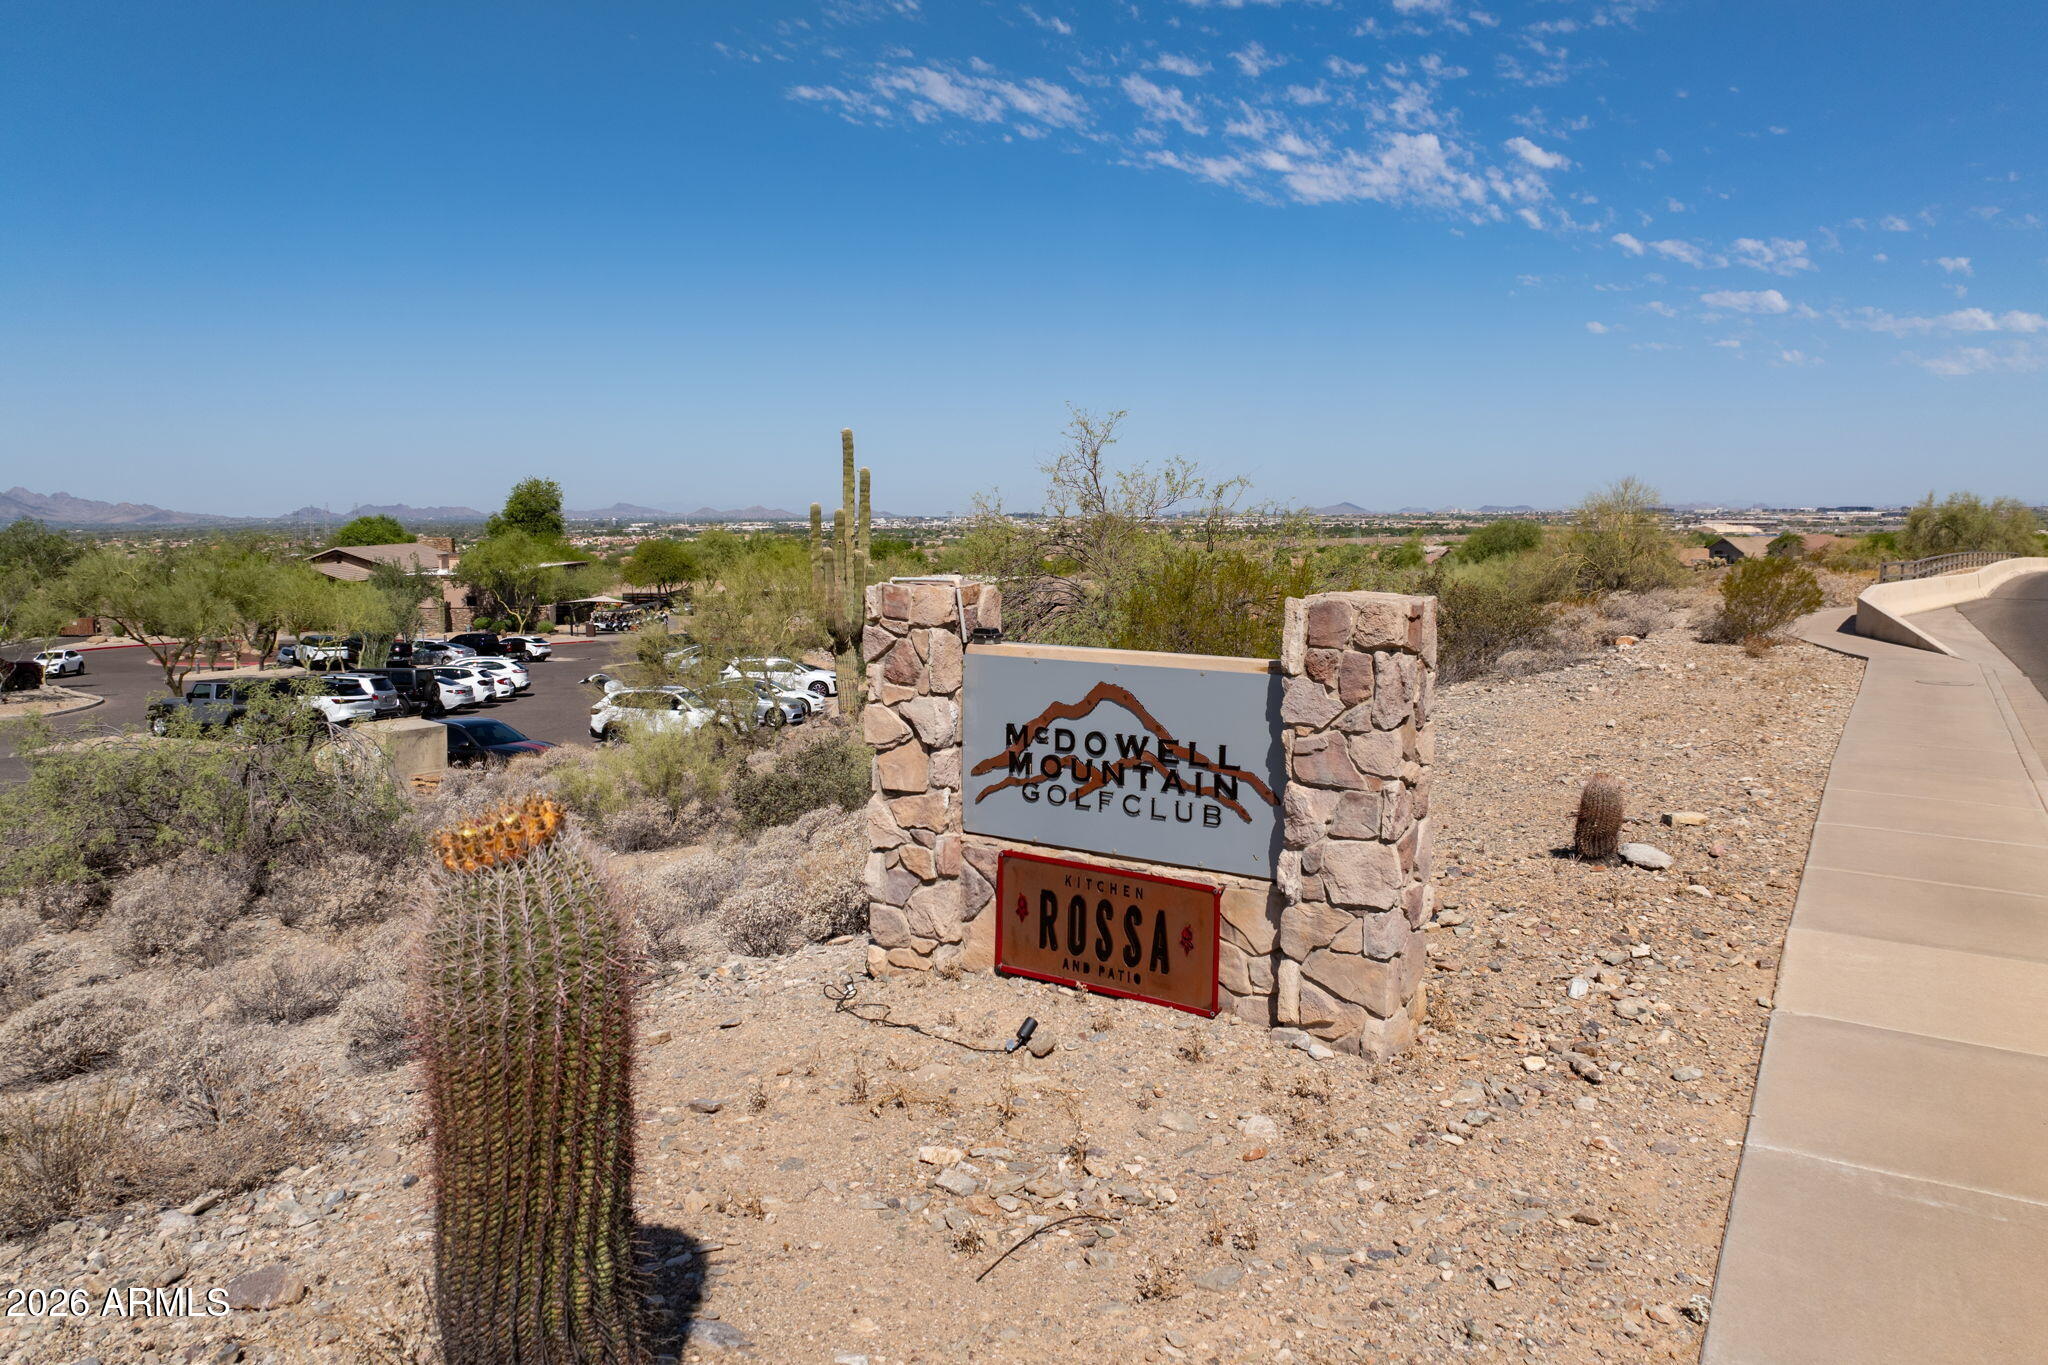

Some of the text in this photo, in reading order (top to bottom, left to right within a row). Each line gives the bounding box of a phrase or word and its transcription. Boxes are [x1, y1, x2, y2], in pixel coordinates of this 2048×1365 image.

[1008, 751, 1238, 800] MOUNTAIN
[1065, 874, 1144, 900] KITCHEN
[1039, 889, 1169, 974] ROSSA
[1062, 958, 1142, 985] AND PATIO
